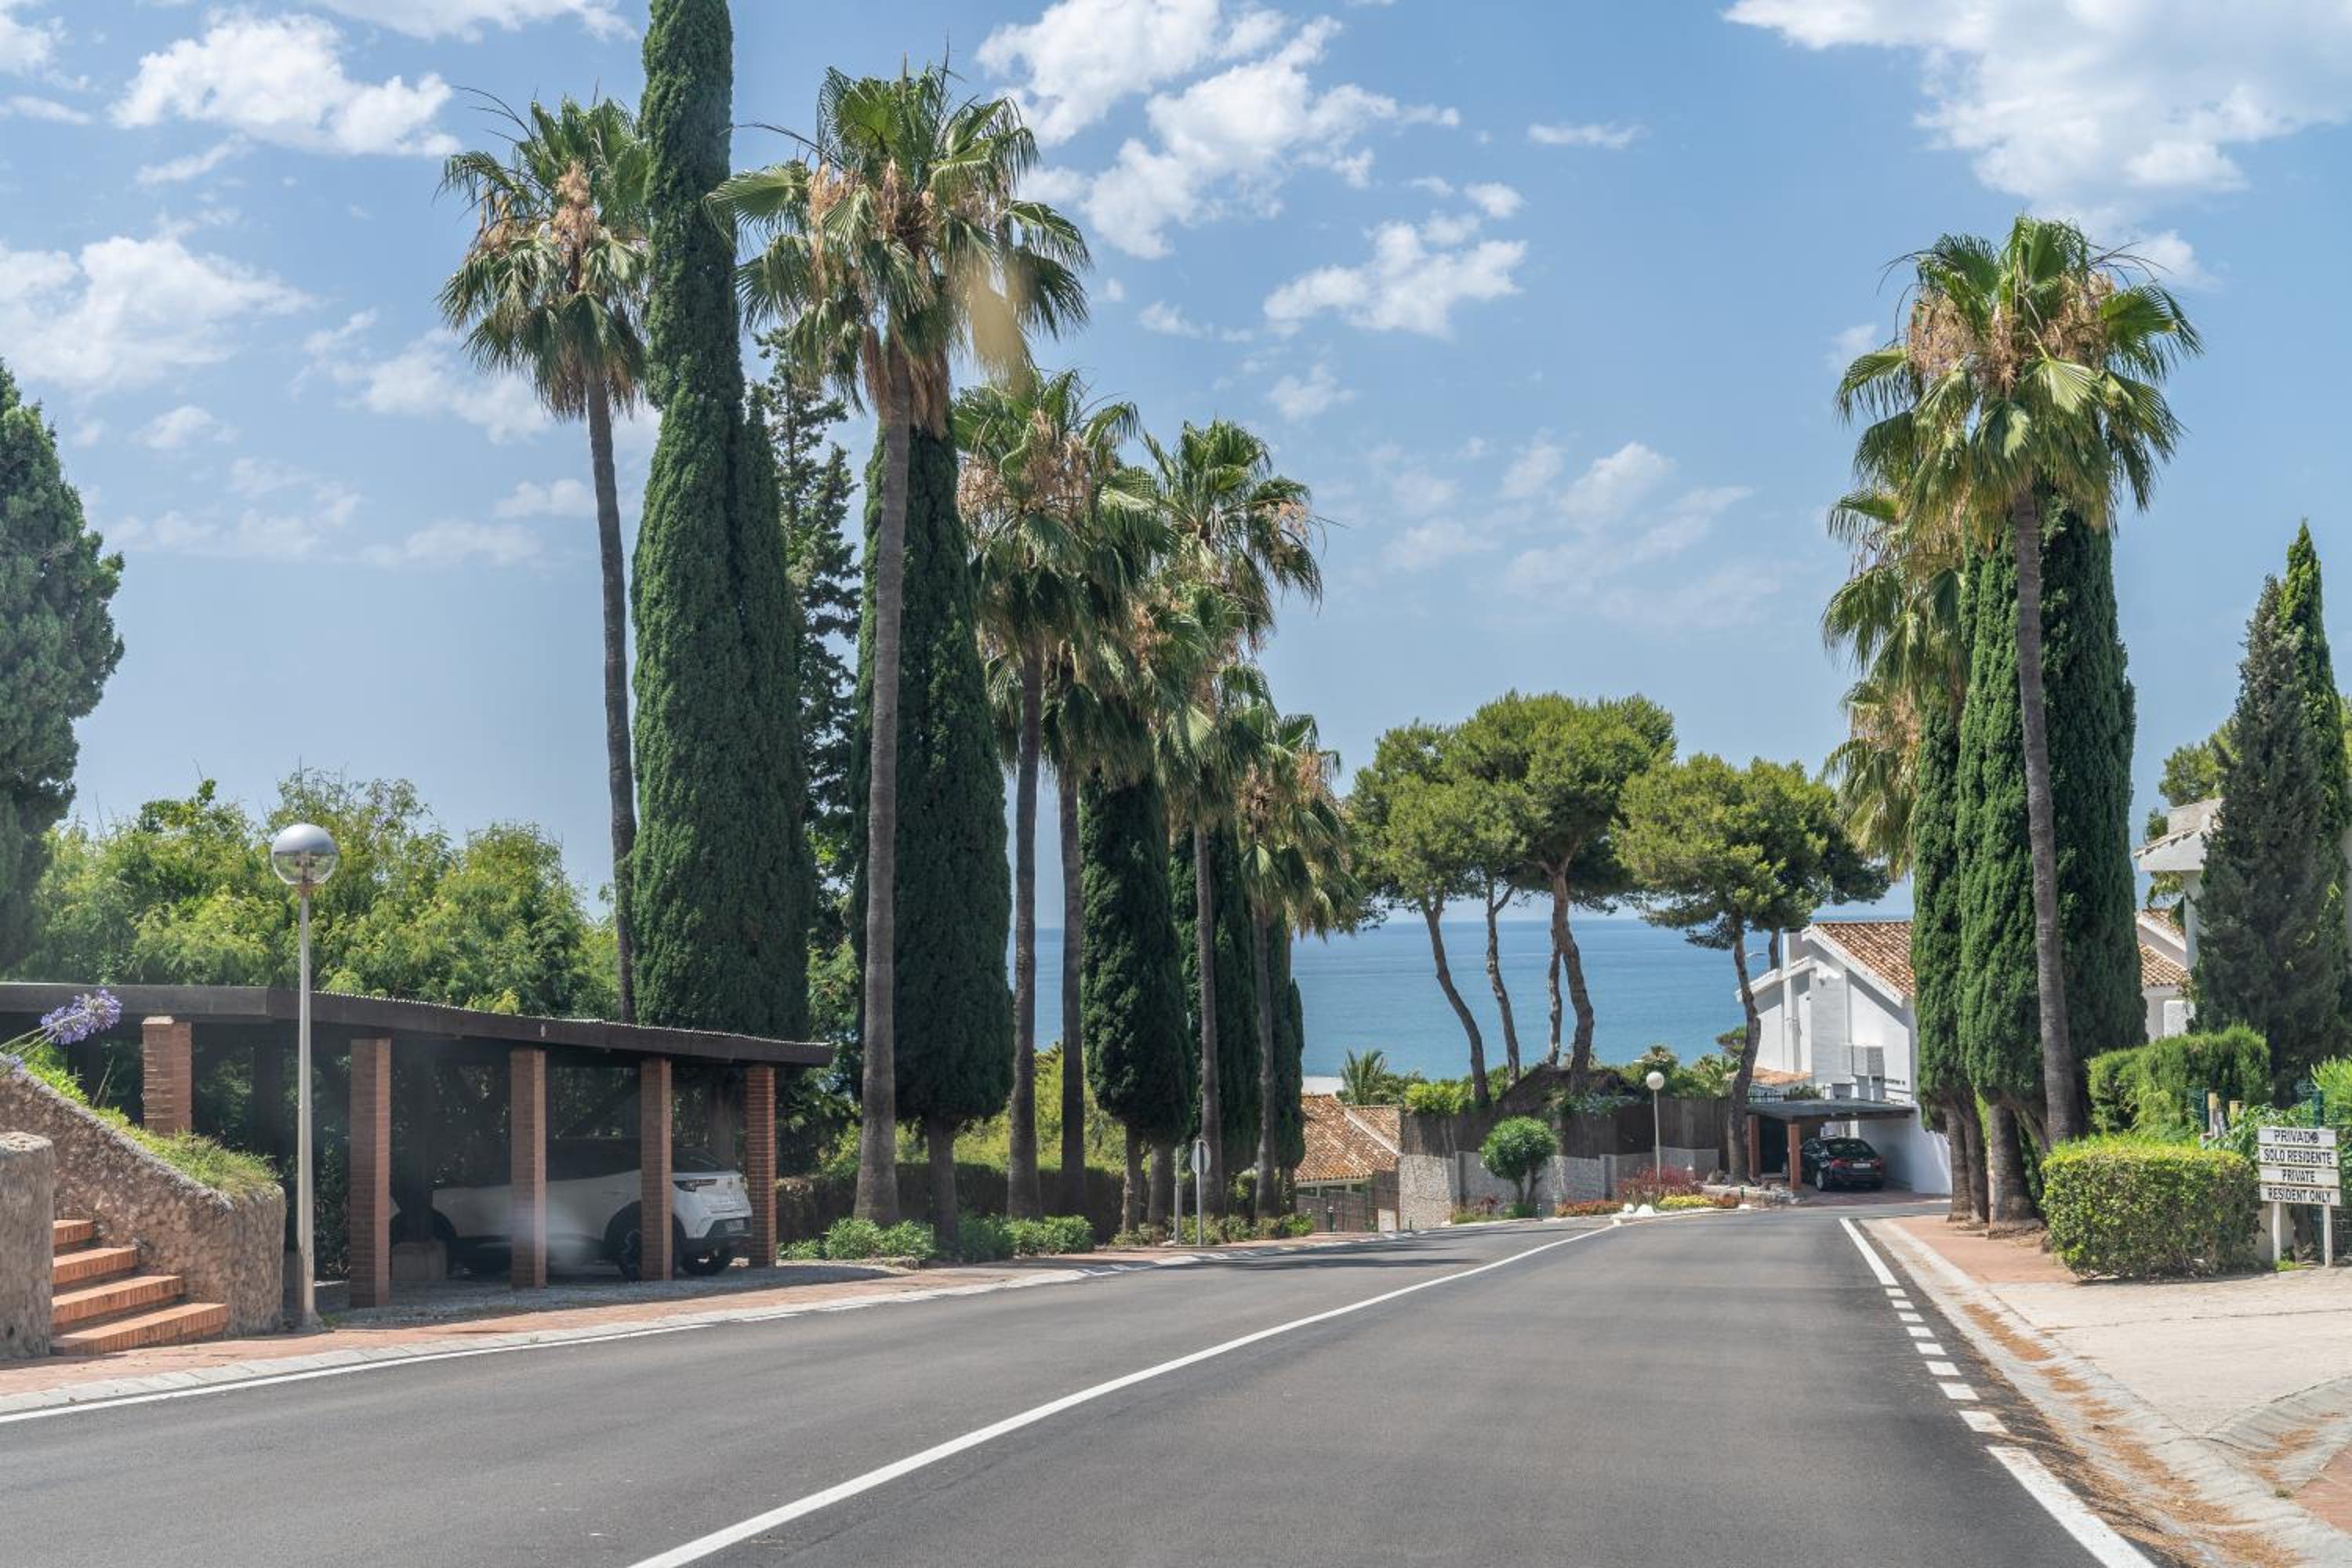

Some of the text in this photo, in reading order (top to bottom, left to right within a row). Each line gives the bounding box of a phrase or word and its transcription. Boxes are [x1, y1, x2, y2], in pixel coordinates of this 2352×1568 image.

[2274, 1130, 2319, 1144] PRIVADO
[2264, 1149, 2332, 1165] SOLO RESIDENTE
[2282, 1169, 2315, 1183] PRIVATE
[2268, 1187, 2332, 1203] RESIDENT ONLY
